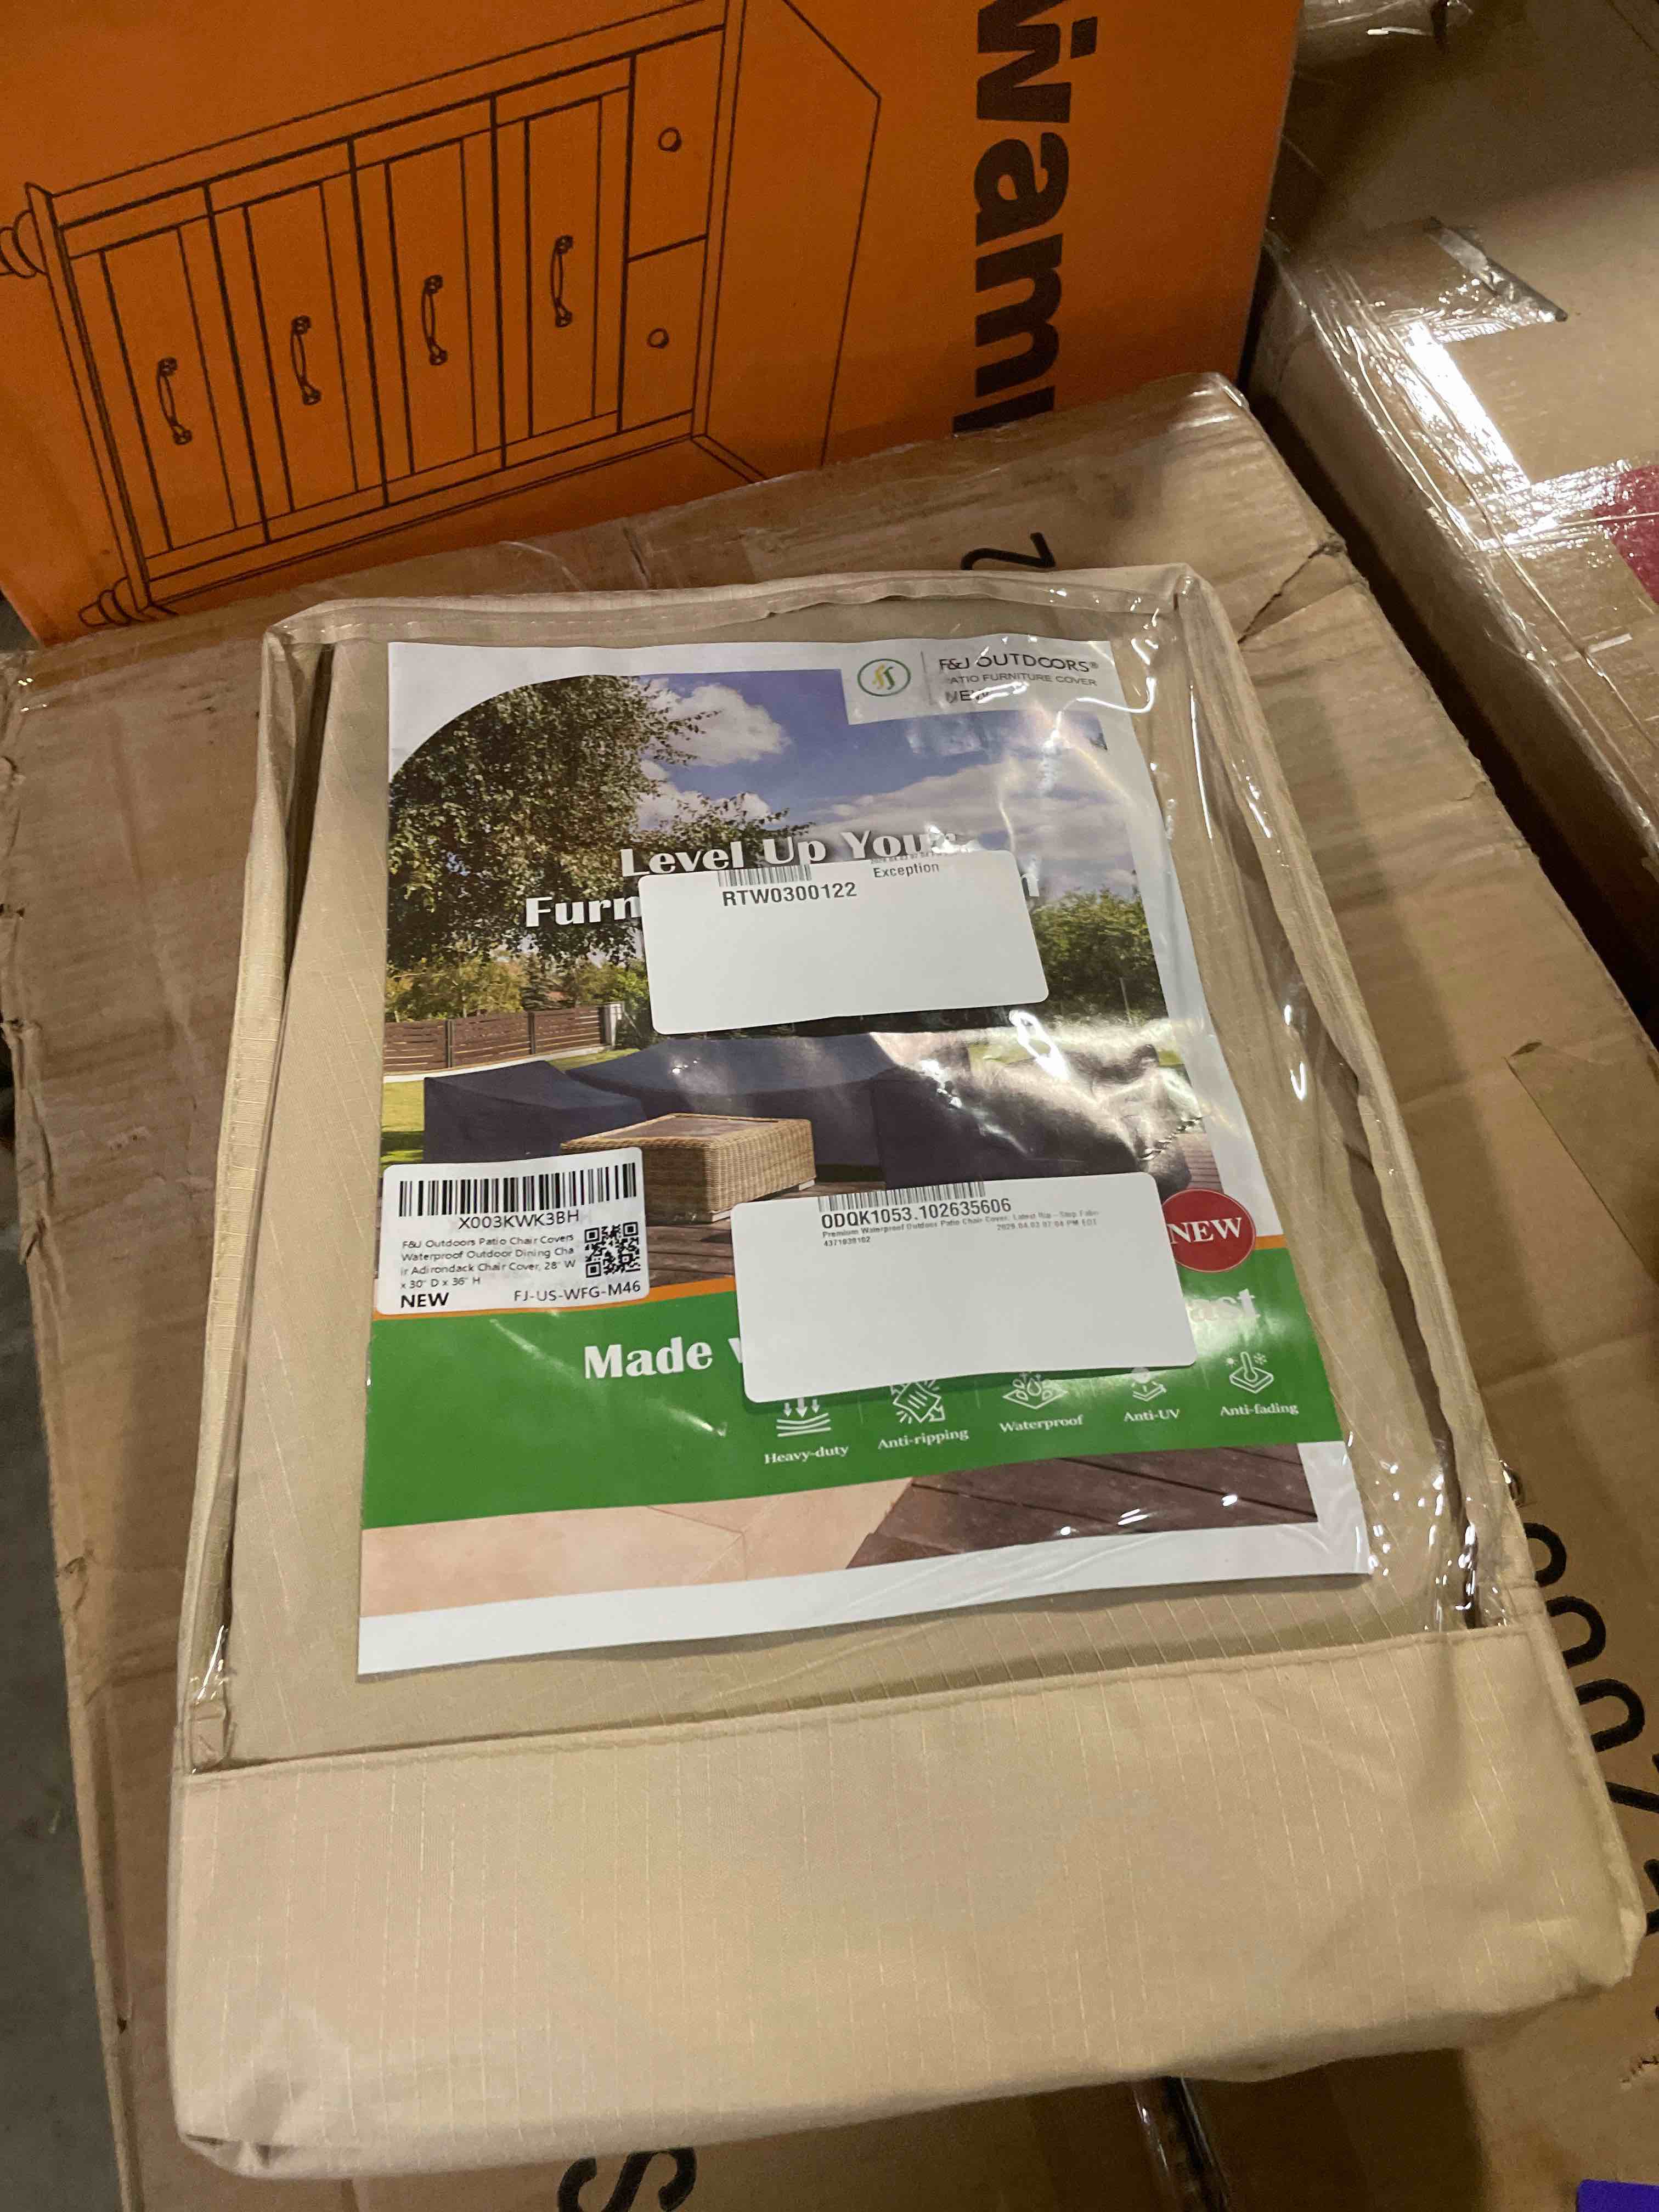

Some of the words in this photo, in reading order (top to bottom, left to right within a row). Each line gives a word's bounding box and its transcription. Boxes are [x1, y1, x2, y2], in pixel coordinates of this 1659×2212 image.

[939, 657, 970, 671] F&J
[947, 674, 979, 685] ATIO
[983, 672, 1052, 682] FURNITURE
[1056, 675, 1098, 686] COVER
[620, 840, 746, 877] Level
[763, 837, 827, 865] Up
[873, 863, 940, 878] Exception
[722, 881, 857, 907] RTW0300122
[459, 1209, 579, 1229] X003KWK3BH
[1166, 1216, 1243, 1245] NEW
[402, 1240, 422, 1249] F&J
[425, 1239, 476, 1248] Outdoors
[479, 1237, 507, 1246] Patio
[510, 1236, 538, 1245] Chair
[540, 1234, 574, 1244] Covers
[401, 1250, 464, 1262] Waterproof
[467, 1250, 512, 1259] Outdoor
[515, 1249, 551, 1259] Dining
[554, 1246, 574, 1256] Cha
[411, 1263, 475, 1275] Adirondack
[478, 1262, 507, 1272] Chair
[564, 1259, 576, 1268] W
[430, 1278, 439, 1287] D
[472, 1277, 481, 1285] H
[514, 1280, 641, 1302] FJ-US-WFG-M46
[400, 1292, 449, 1308] NEW
[584, 1336, 713, 1379] Made
[1123, 1408, 1181, 1423] Anti-UV
[1220, 1402, 1300, 1417] Anti-fading
[999, 1414, 1085, 1434] Waterproof
[878, 1429, 970, 1449] Anti-ripping
[764, 1444, 849, 1464] Heavy-duty
